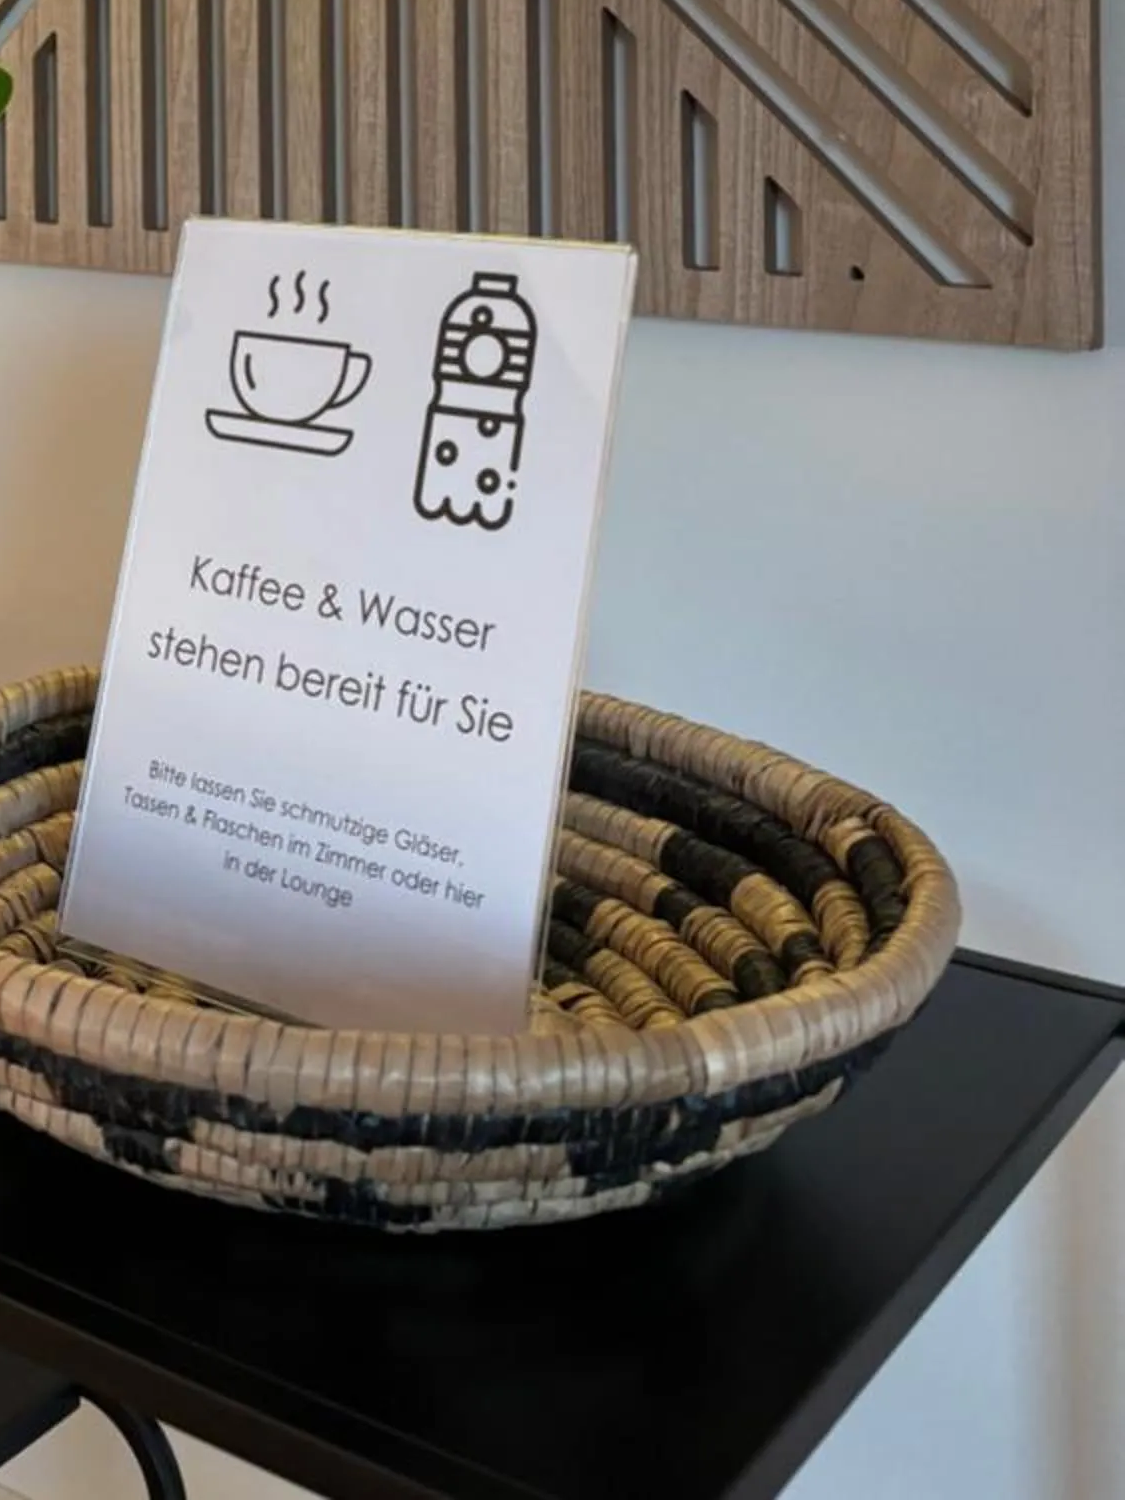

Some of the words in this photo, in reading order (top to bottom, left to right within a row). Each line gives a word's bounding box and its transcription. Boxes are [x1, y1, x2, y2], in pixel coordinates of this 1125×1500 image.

[190, 554, 306, 612] Kaffee
[317, 583, 344, 622] &
[359, 587, 497, 652] Wasser
[147, 626, 266, 685] stehen
[275, 651, 386, 713] bereit
[396, 679, 450, 726] für
[455, 693, 515, 743] Sie
[124, 785, 180, 819] Tassen
[184, 804, 197, 826] &
[202, 808, 284, 851] Flaschen
[286, 833, 311, 859] im
[314, 841, 388, 881] Zimmer
[391, 866, 440, 898] oder
[444, 877, 486, 910] hier
[148, 758, 188, 788] Bitte
[190, 771, 246, 803] lassen
[249, 787, 277, 813] Sie
[280, 800, 389, 846] schmutzige
[223, 849, 241, 873] in
[243, 857, 277, 885] der
[279, 866, 354, 910] Lounge
